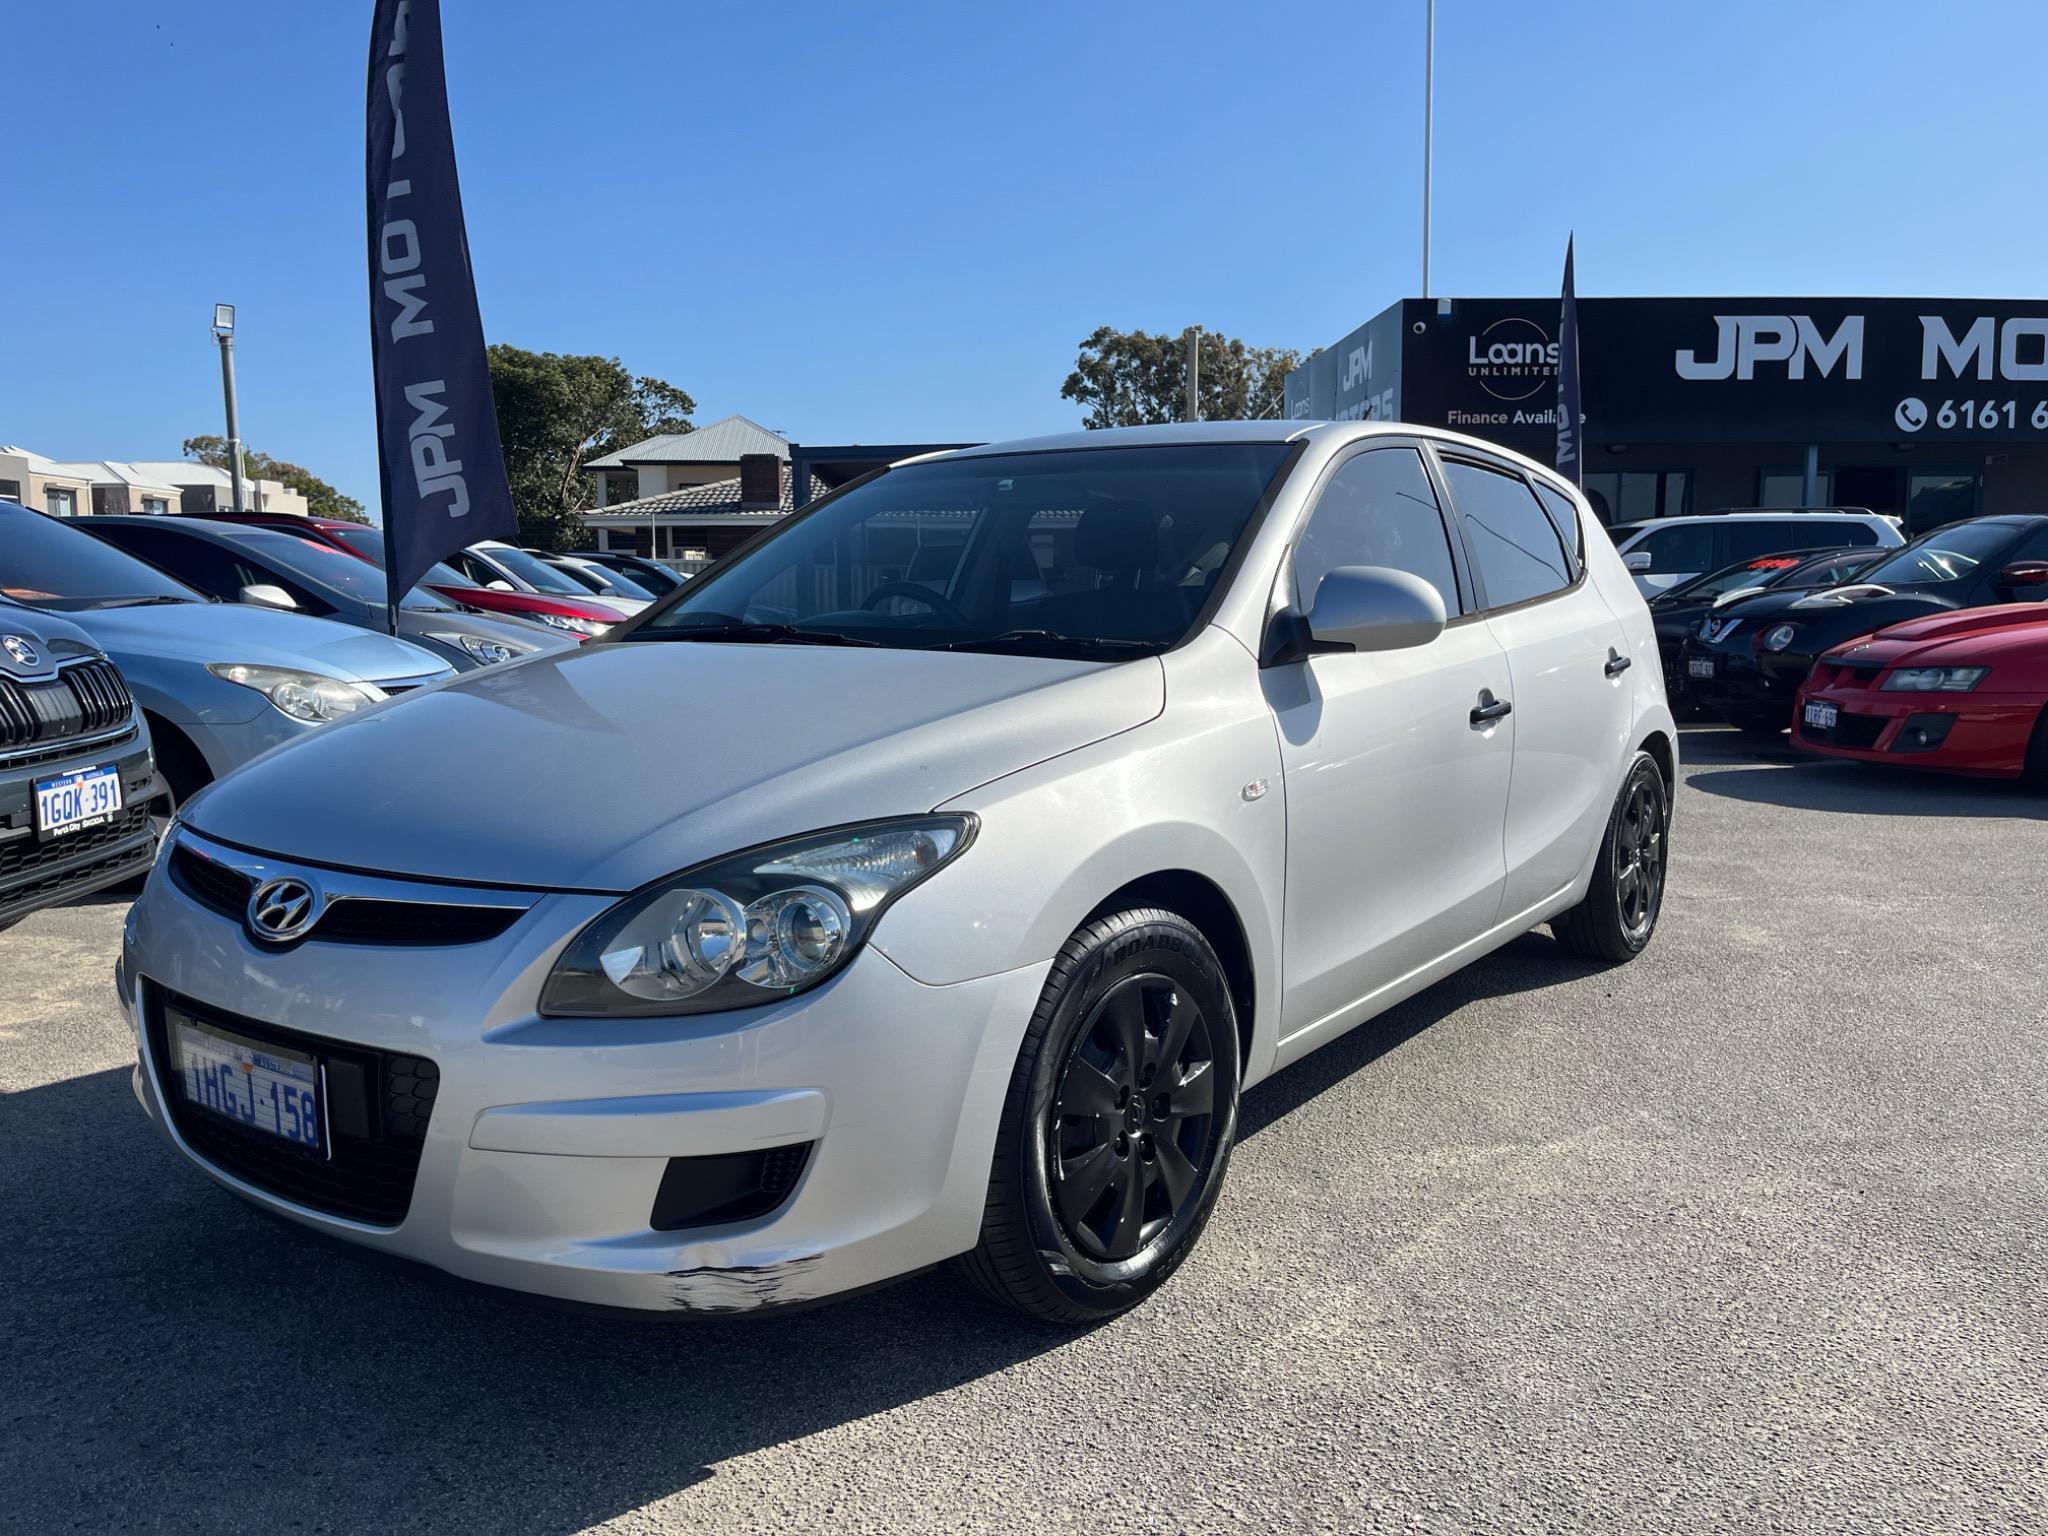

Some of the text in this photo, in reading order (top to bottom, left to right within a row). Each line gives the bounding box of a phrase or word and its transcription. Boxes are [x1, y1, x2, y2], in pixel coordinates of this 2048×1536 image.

[1342, 340, 1373, 392] JPM
[1469, 335, 1560, 365] Loans
[1675, 315, 1865, 381] JPM
[1447, 408, 1587, 425] Finance Availae
[1935, 399, 2048, 430] 6161 6
[404, 379, 471, 518] JPM
